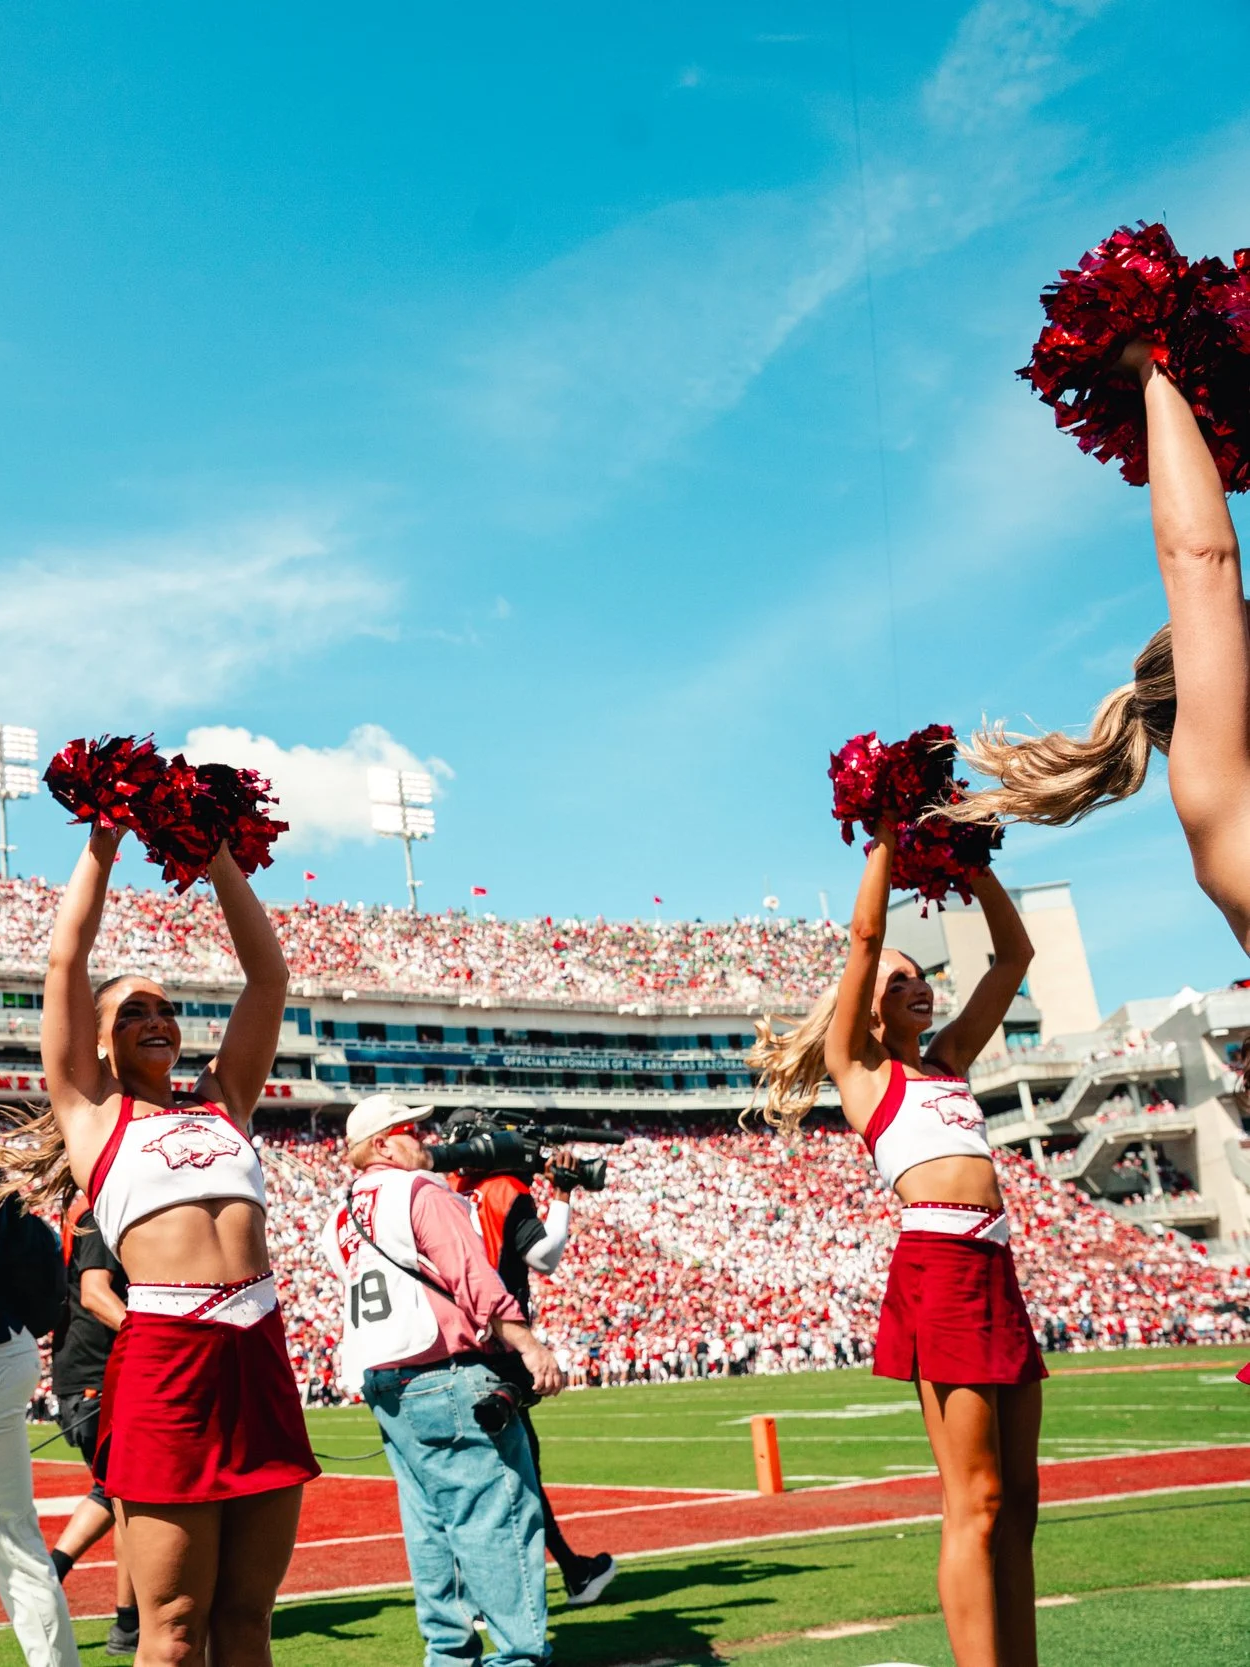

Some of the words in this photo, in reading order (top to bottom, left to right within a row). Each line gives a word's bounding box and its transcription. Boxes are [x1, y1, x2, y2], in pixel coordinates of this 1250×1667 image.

[503, 1055, 547, 1067] OFFICIAL
[550, 1057, 610, 1070] MAYONNAISE
[612, 1059, 624, 1070] OF
[626, 1059, 643, 1070] THE
[645, 1060, 696, 1071] ARKANSAS
[351, 1269, 392, 1329] 19
